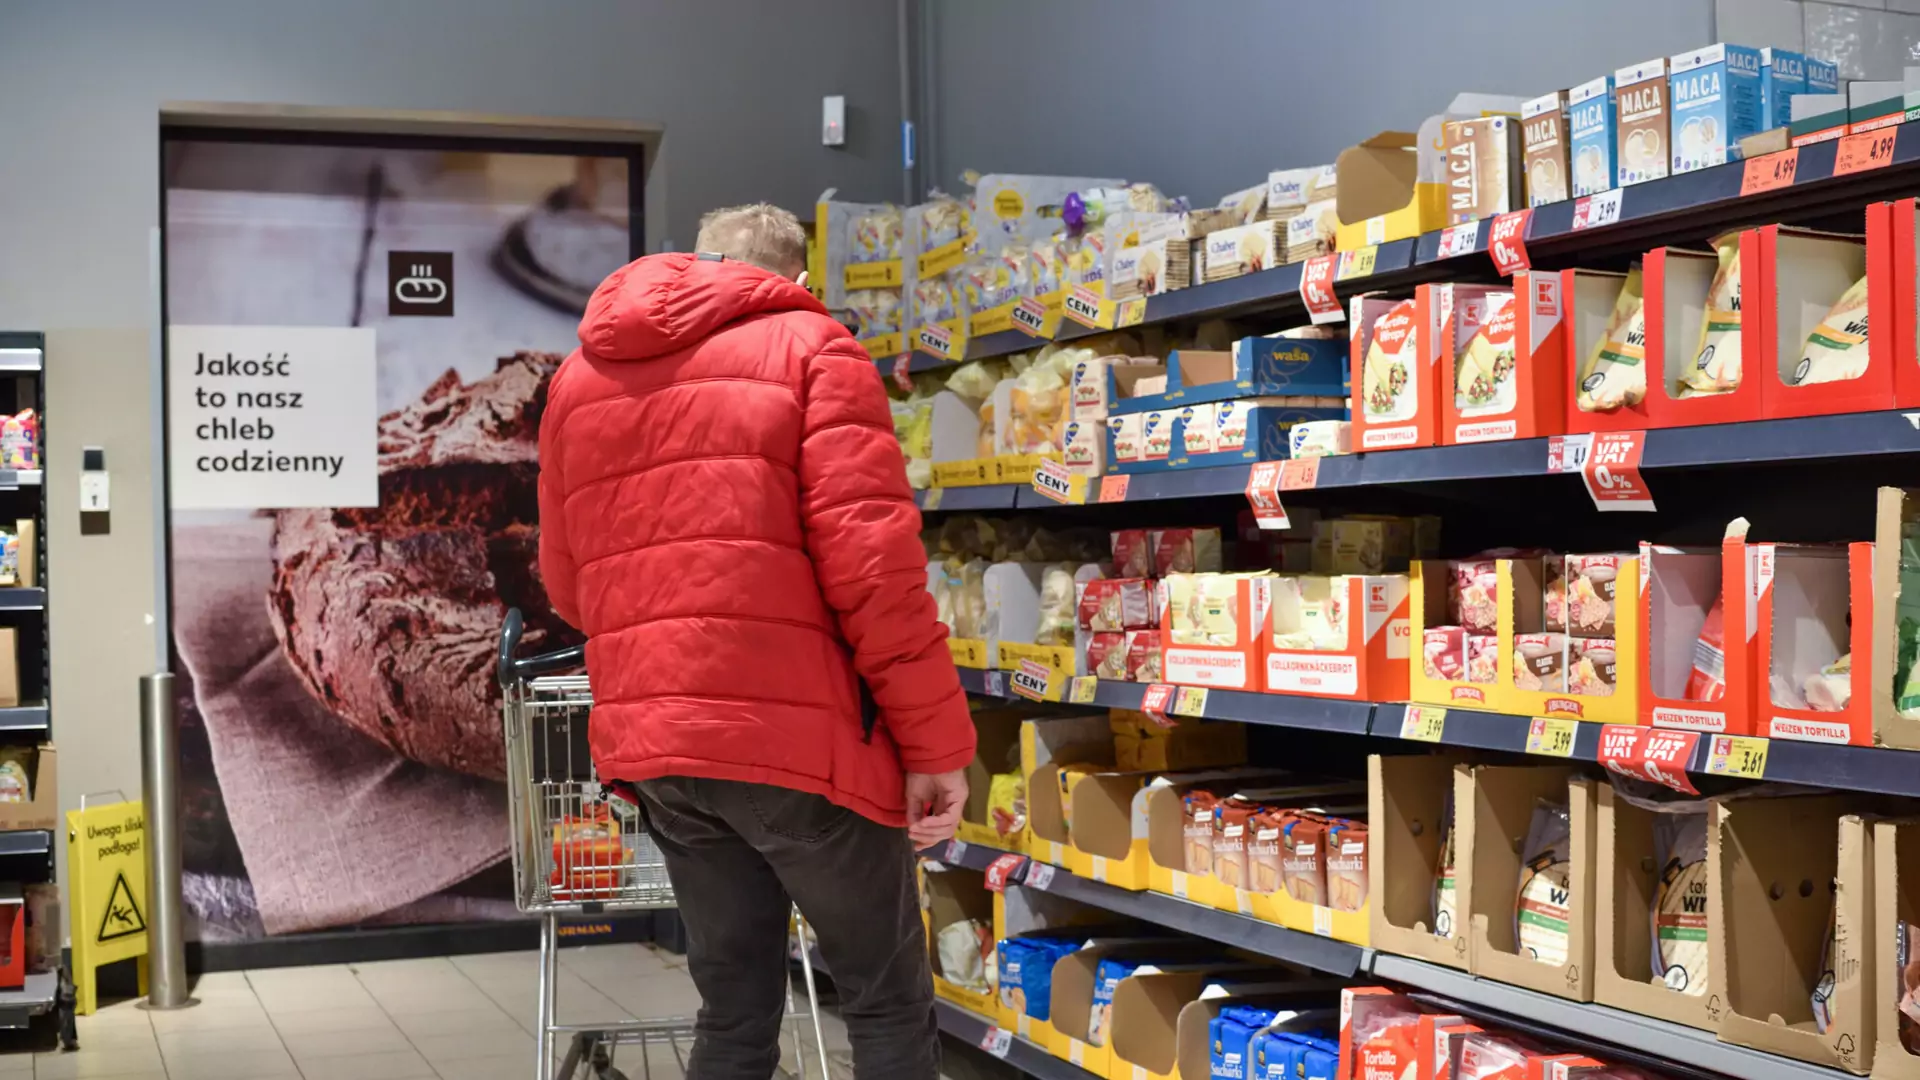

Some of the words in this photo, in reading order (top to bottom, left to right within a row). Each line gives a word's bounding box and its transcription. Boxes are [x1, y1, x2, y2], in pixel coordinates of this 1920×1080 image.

[1727, 51, 1759, 72] MACA
[1772, 57, 1804, 76] MACA
[1675, 71, 1721, 101] MACA
[1621, 86, 1661, 115] MACA
[1572, 103, 1603, 132] MACA
[1525, 118, 1557, 146] MACA
[1869, 136, 1893, 160] 4.99
[1451, 142, 1472, 210] MACA
[1774, 158, 1795, 181] 4.99
[1598, 200, 1616, 221] 2.99
[1495, 241, 1519, 266] 0%
[1013, 307, 1043, 329] CENY
[1067, 297, 1098, 319] CENY
[920, 332, 950, 352] CENY
[195, 352, 290, 377] Jakość
[195, 387, 226, 408] to
[237, 391, 303, 409] nasz
[196, 417, 275, 440] chleb
[196, 449, 344, 478] codzienny
[1595, 442, 1634, 463] VAT
[1036, 471, 1069, 493] CENY
[1595, 465, 1632, 489] 0%
[1015, 671, 1047, 693] CENY
[1426, 719, 1443, 736] 3.99
[1656, 711, 1684, 724] WEIZEN
[1685, 715, 1722, 727] TORTILLA
[1553, 731, 1571, 750] 3.99
[1774, 723, 1803, 735] WEIZEN
[1805, 727, 1846, 739] TORTILLA
[1604, 734, 1638, 758] VAT
[1644, 738, 1686, 761] VAT
[1644, 760, 1681, 786] 0%
[1741, 751, 1764, 774] 3.61
[87, 823, 122, 840] Uwaga
[98, 838, 140, 860] podłoga!
[1364, 1050, 1396, 1066] Tortilla
